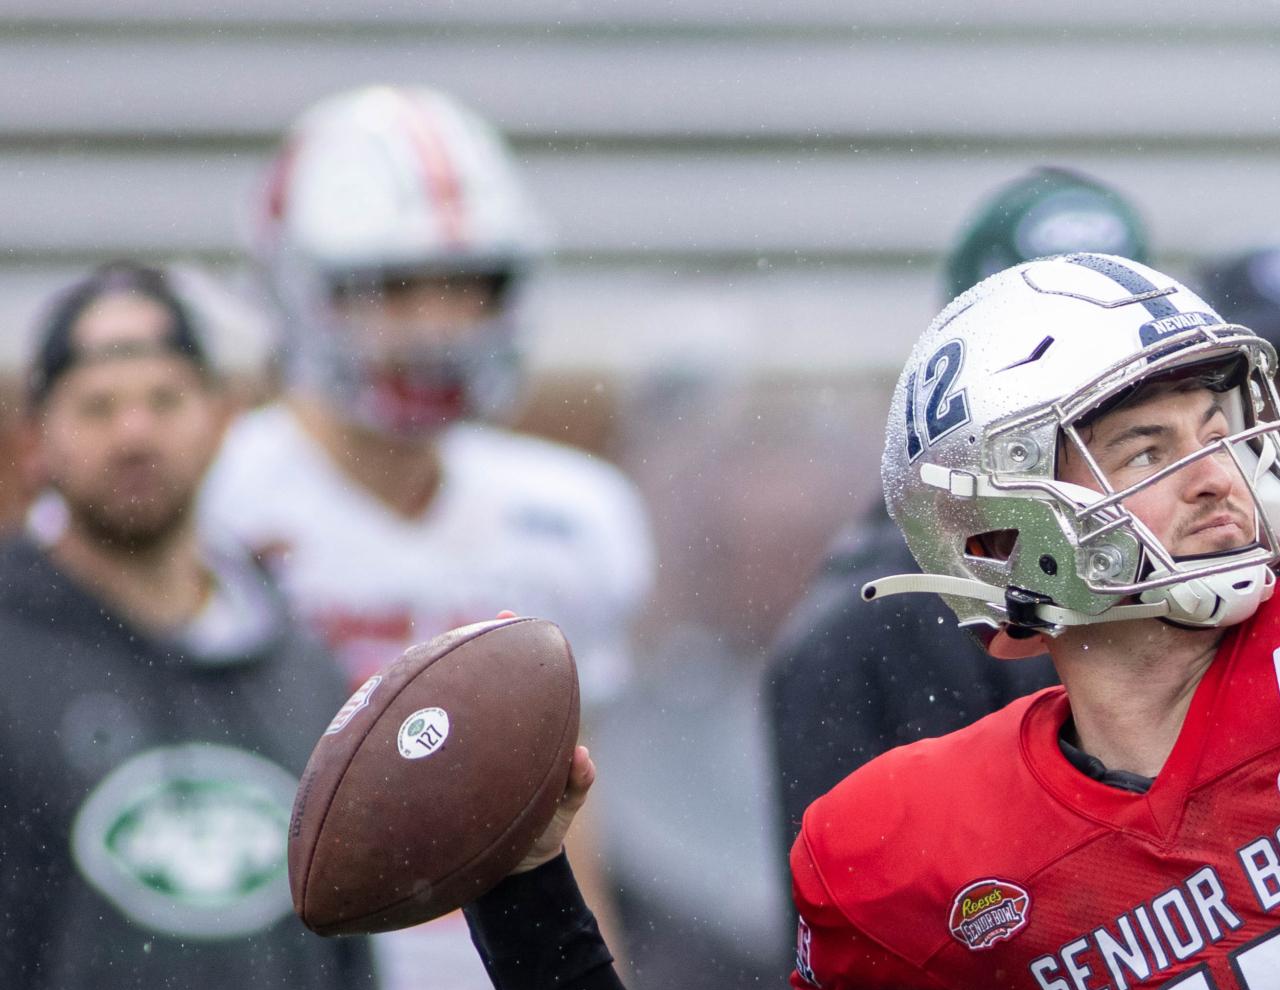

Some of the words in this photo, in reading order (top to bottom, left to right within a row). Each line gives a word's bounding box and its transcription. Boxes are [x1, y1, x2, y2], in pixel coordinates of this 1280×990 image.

[1152, 312, 1208, 335] NEVADA
[904, 337, 973, 465] 12
[415, 723, 443, 751] 127
[963, 911, 995, 942] SENIOR
[994, 902, 1020, 926] BOWL
